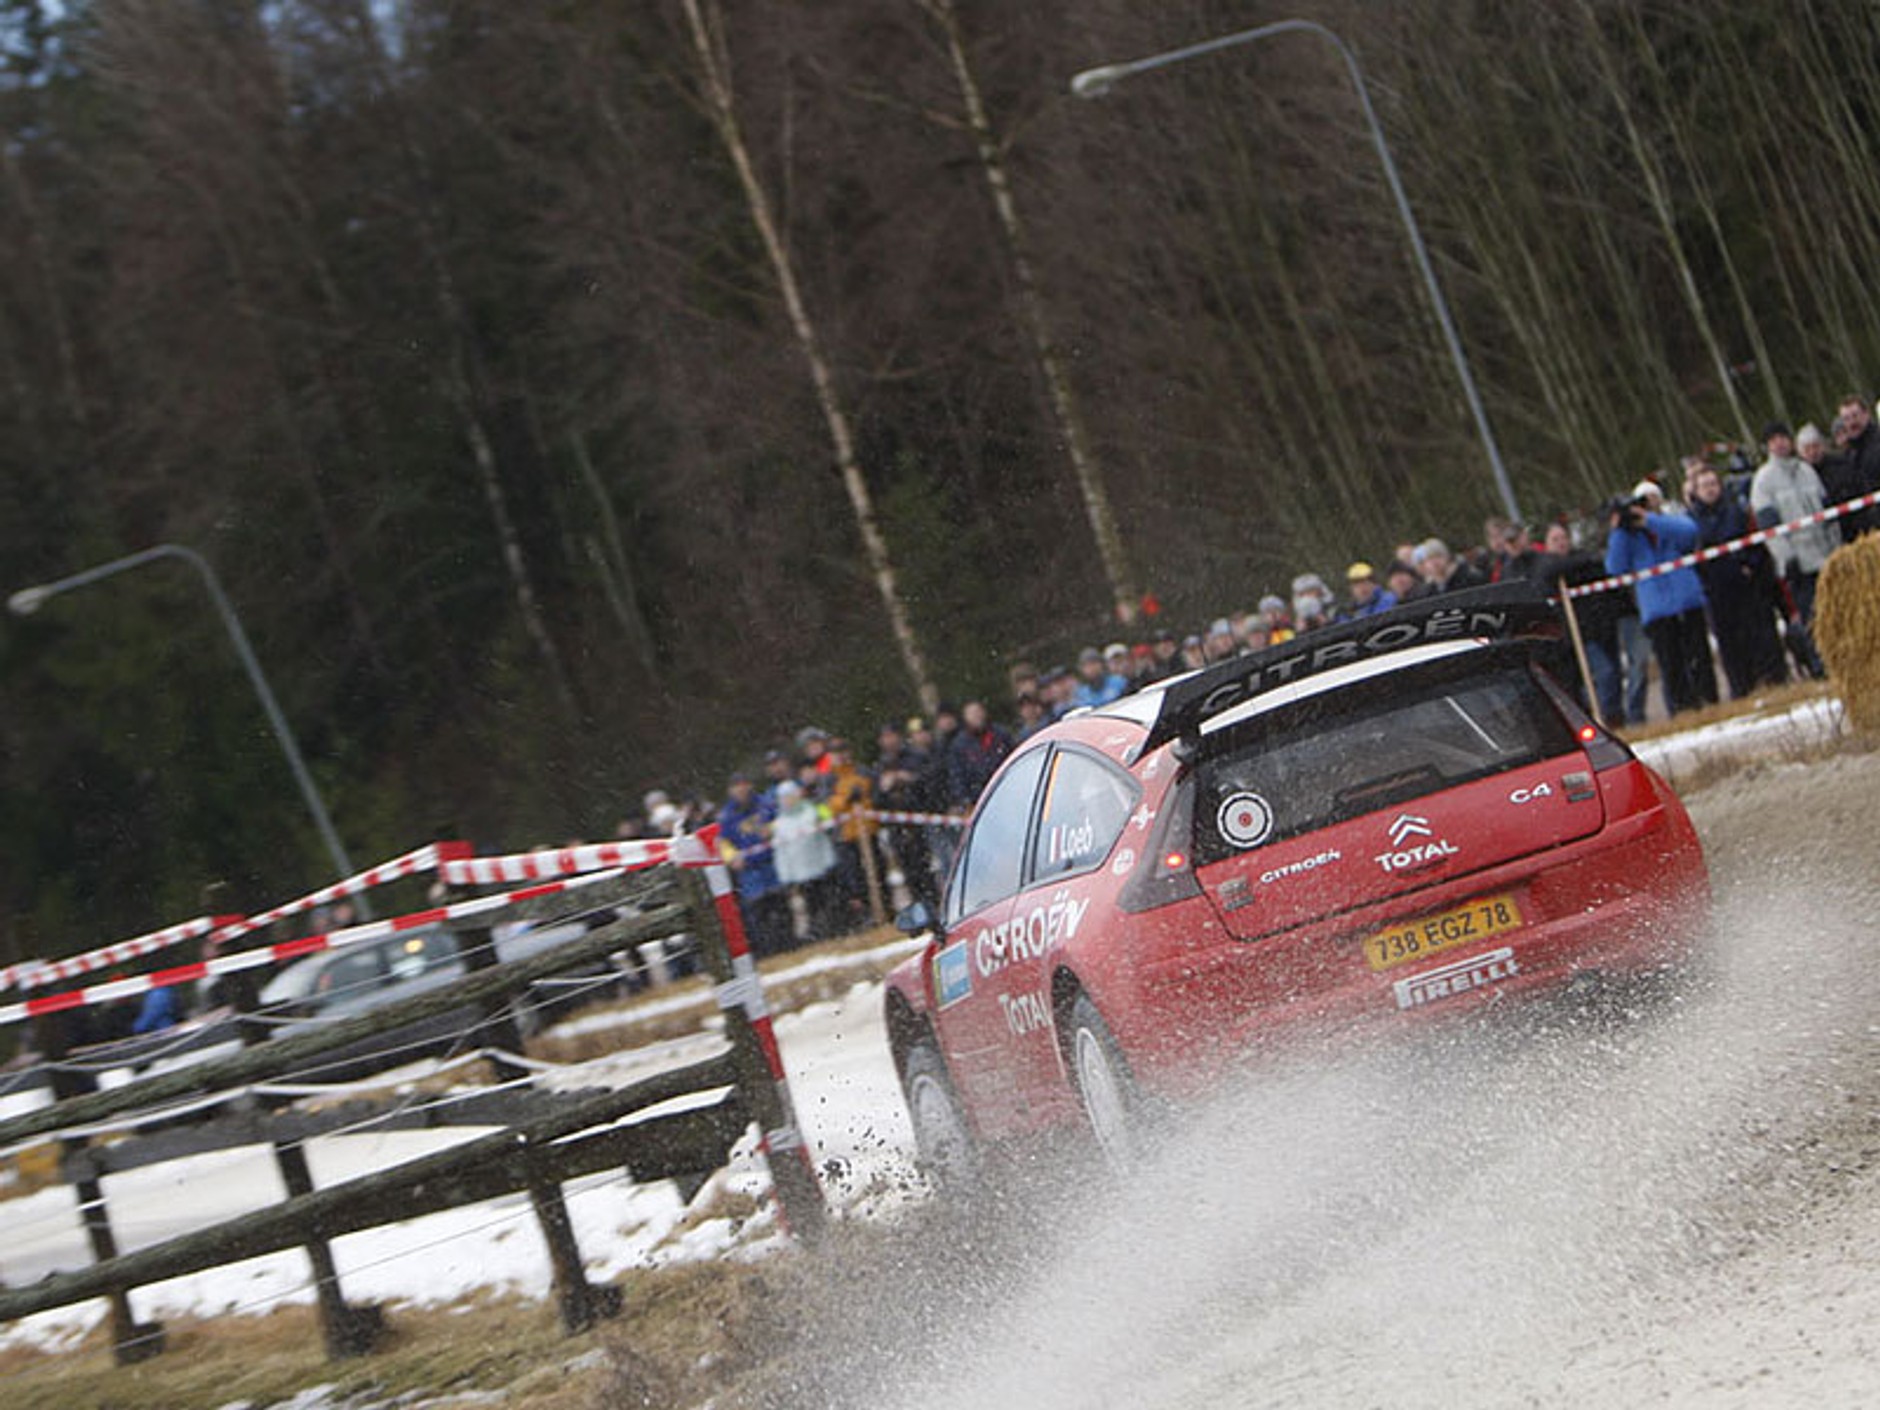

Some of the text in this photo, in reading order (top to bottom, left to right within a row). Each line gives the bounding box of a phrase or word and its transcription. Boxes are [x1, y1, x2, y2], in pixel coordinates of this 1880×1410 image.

[1201, 608, 1506, 713] CITROËN
[1510, 782, 1552, 803] C4
[1060, 816, 1093, 860] Loeb
[1374, 840, 1459, 872] TOTAL
[1375, 902, 1511, 961] 738 EGZ 78
[1393, 946, 1521, 1009] PIRELLI
